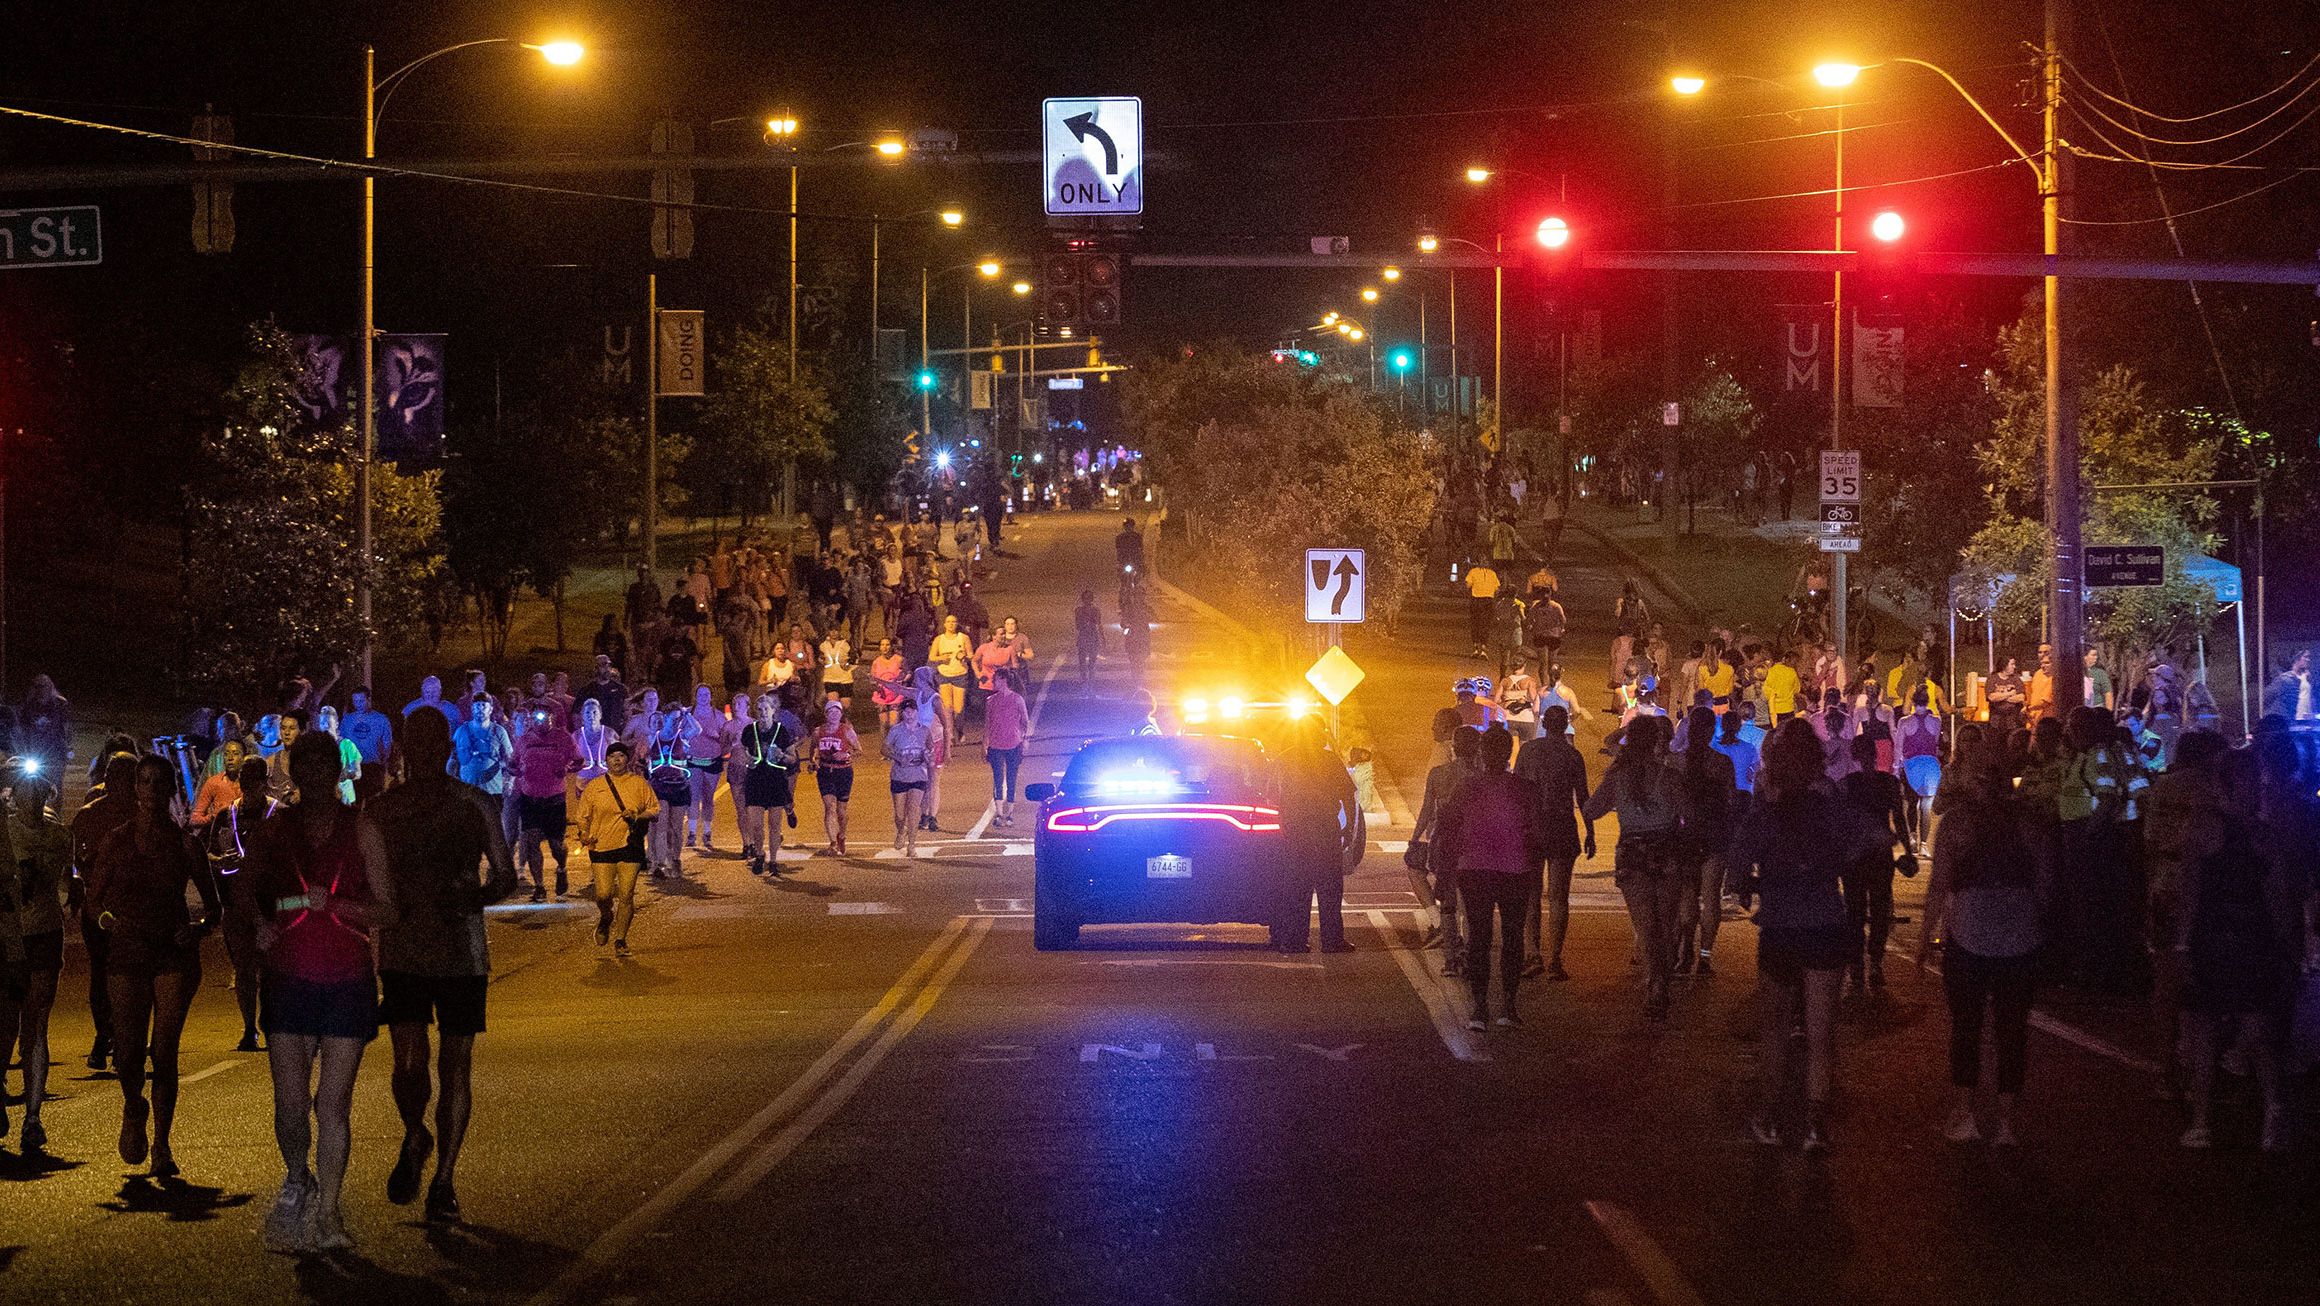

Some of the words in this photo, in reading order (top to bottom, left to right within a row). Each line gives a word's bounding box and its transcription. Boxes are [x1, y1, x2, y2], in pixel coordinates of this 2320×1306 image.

[1060, 182, 1128, 204] ONLY
[30, 216, 88, 258] St.
[679, 319, 694, 381] DOING
[1823, 456, 1857, 465] SPEED
[1827, 466, 1853, 475] LIMIT
[1825, 477, 1857, 495] 35
[1822, 523, 1837, 531] BIKE
[1829, 540, 1852, 549] AHEAD
[2088, 554, 2113, 566] David
[2126, 553, 2161, 565] Sullivan
